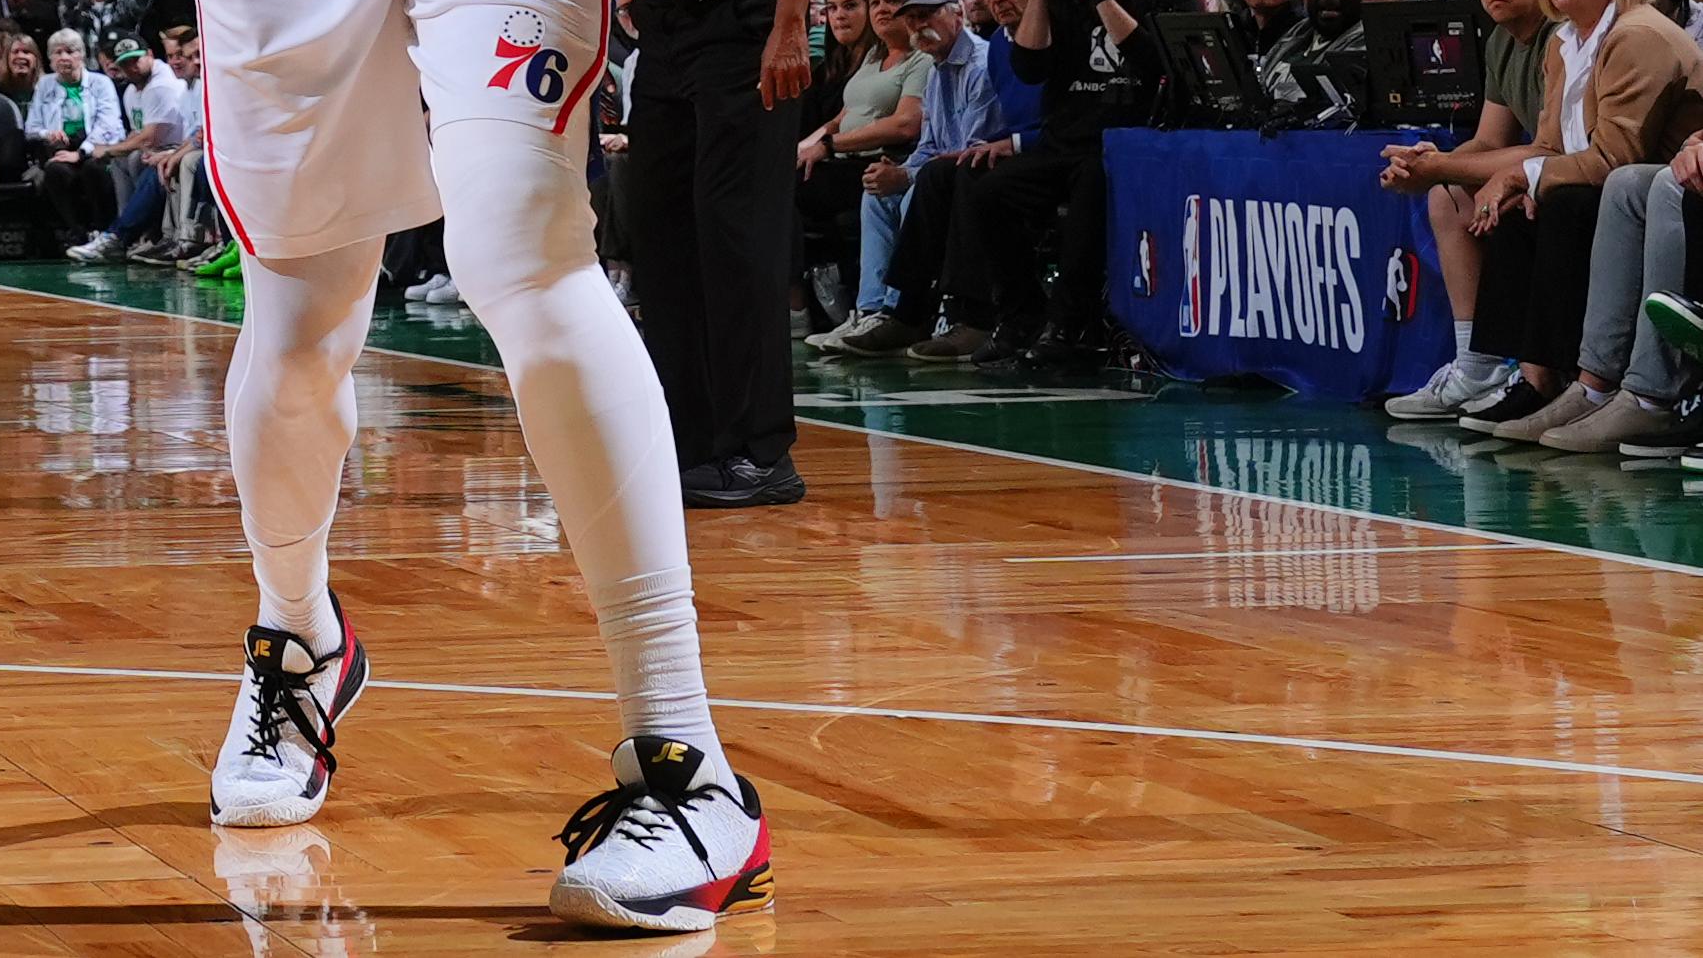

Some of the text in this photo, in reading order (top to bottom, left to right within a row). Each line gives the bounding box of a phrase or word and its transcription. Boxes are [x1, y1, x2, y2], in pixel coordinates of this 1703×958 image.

[487, 35, 569, 104] 76
[1207, 197, 1365, 354] PLAYOFFS
[651, 741, 689, 763] JE
